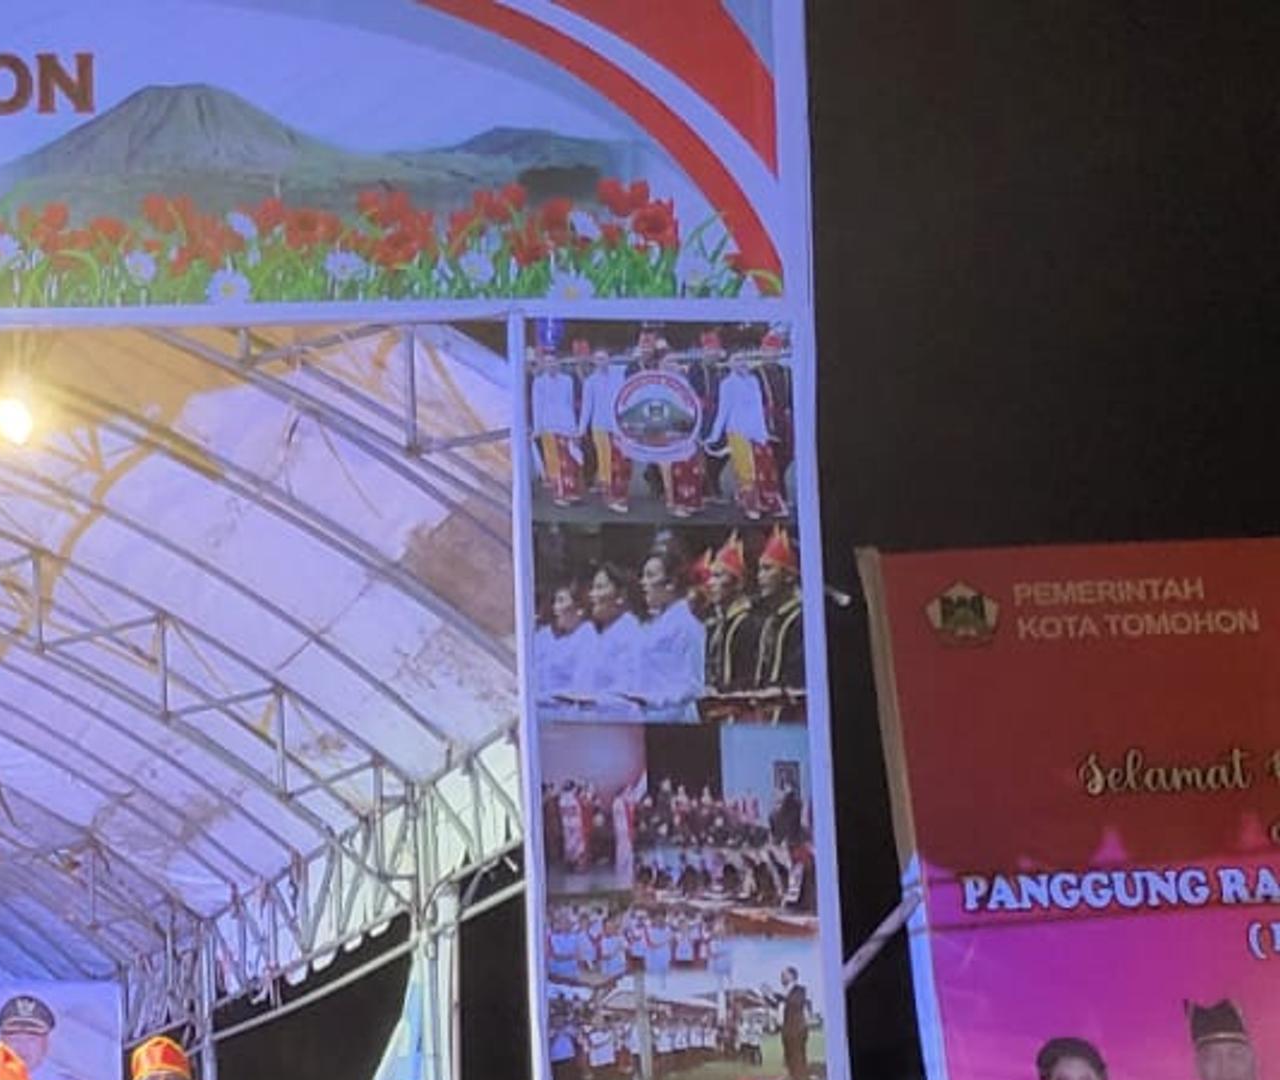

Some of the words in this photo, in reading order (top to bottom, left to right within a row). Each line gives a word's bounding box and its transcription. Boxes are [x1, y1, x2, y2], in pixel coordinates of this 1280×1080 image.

[1013, 577, 1204, 606] PEMERINTAH
[1018, 613, 1098, 640] KOTA
[1104, 608, 1260, 638] TOMOHON
[1079, 748, 1251, 795] Selamat
[963, 868, 1210, 911] PANGGUNG
